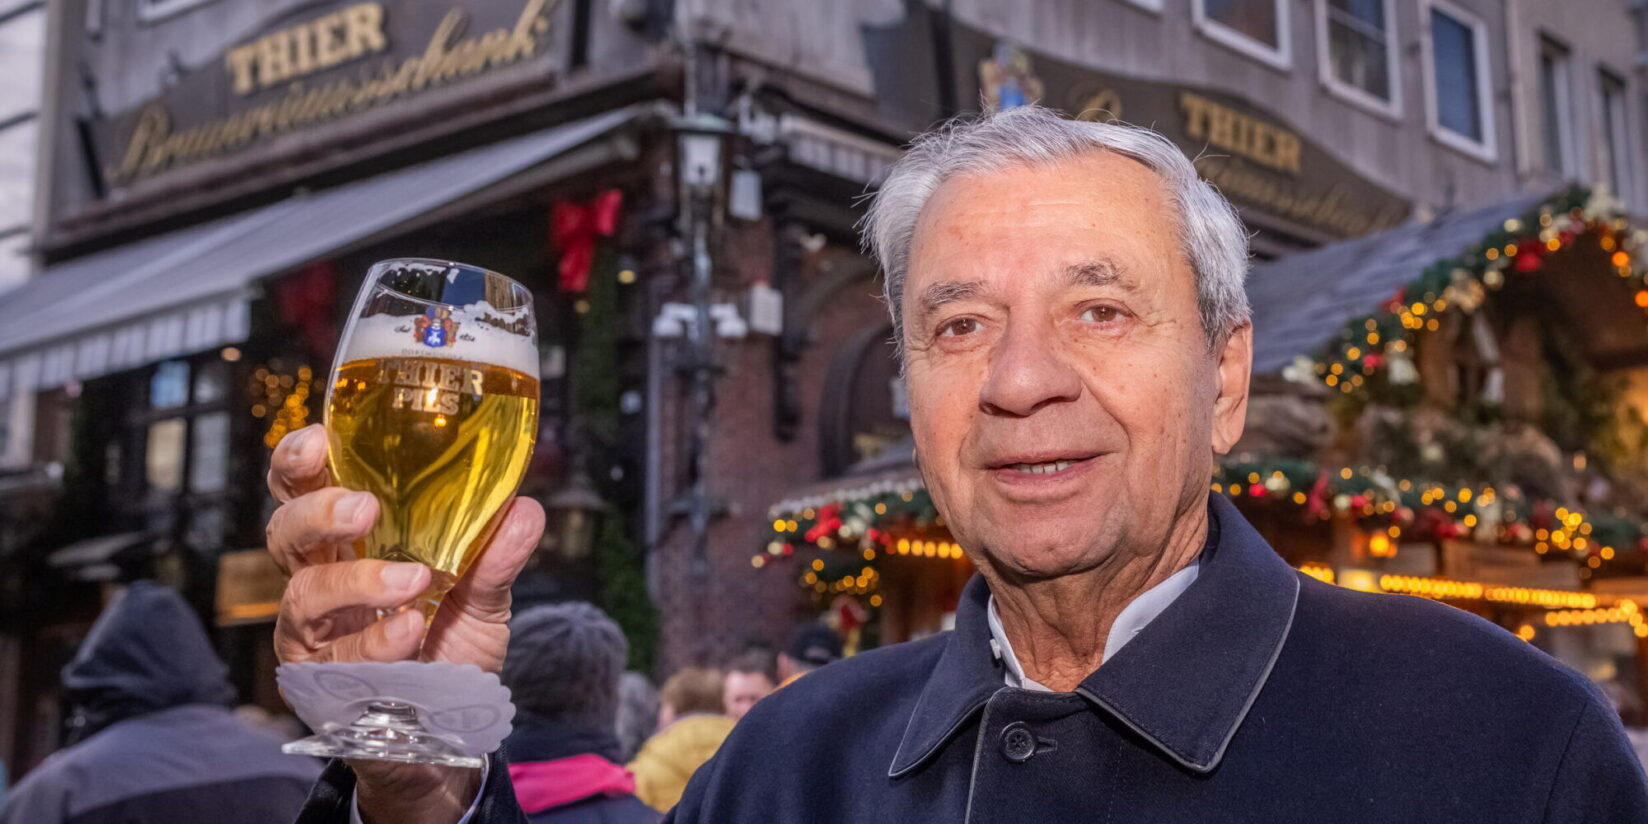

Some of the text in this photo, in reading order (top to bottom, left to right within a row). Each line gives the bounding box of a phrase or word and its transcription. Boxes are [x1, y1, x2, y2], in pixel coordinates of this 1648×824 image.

[226, 2, 387, 94] THIER
[1179, 91, 1303, 174] THIER
[377, 359, 484, 398] THIER
[391, 387, 461, 416] PILS
